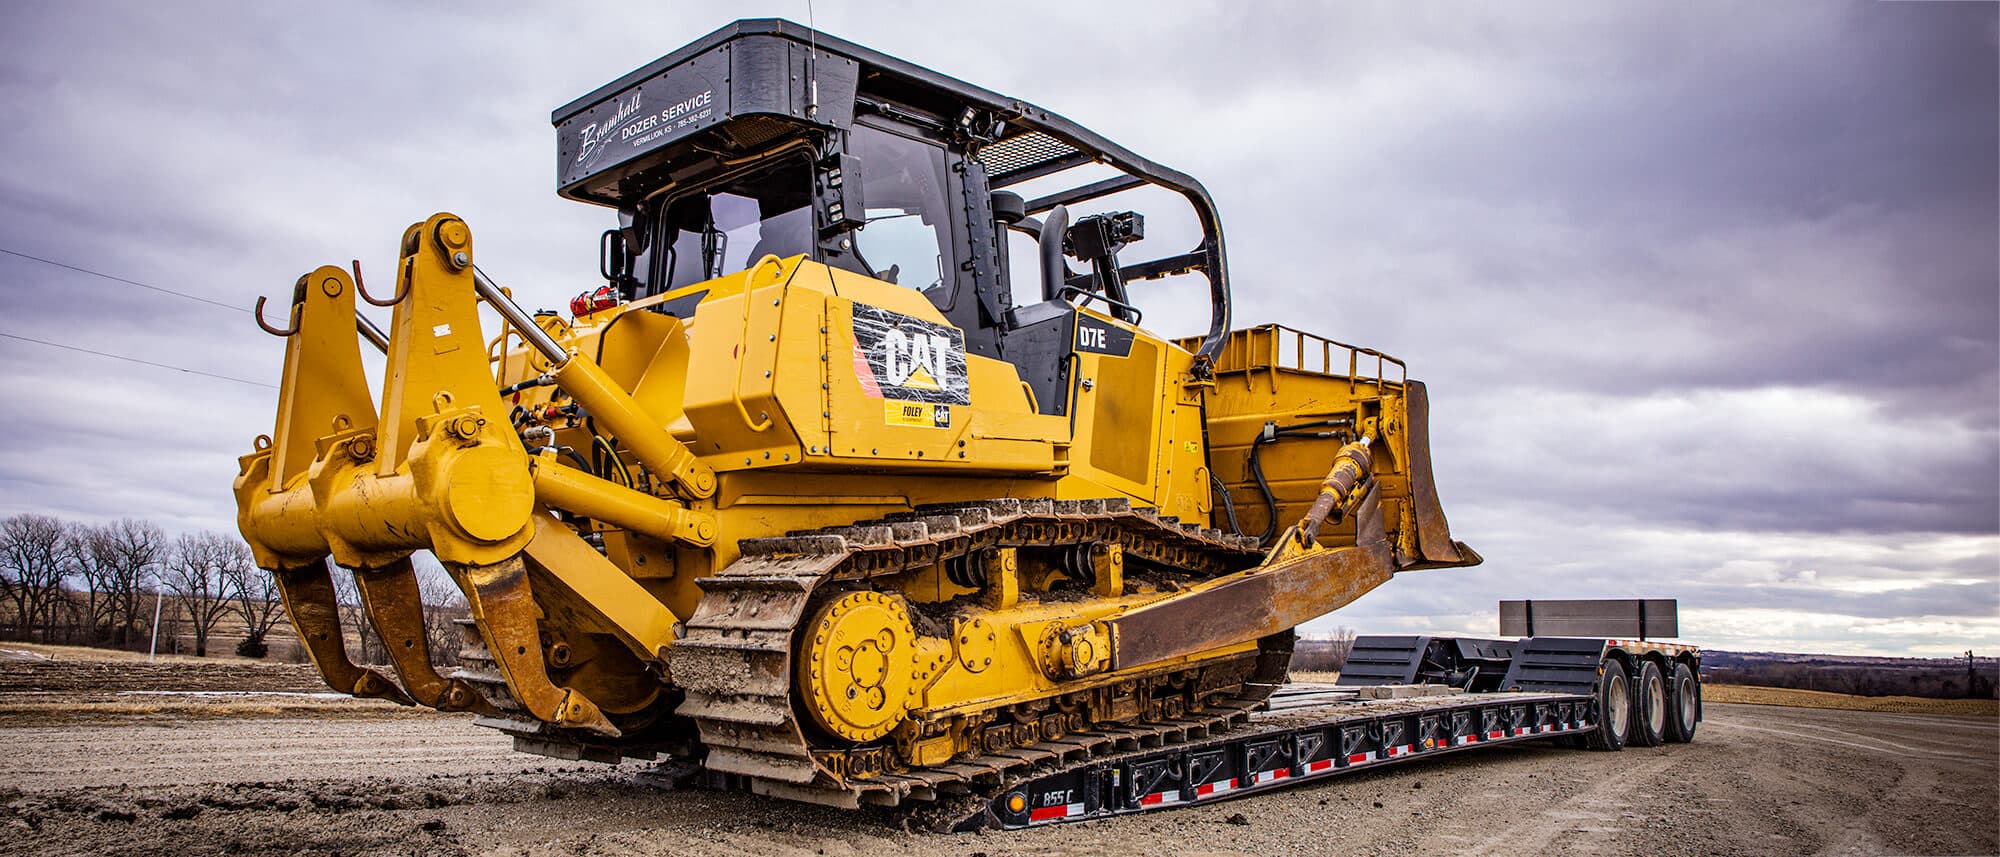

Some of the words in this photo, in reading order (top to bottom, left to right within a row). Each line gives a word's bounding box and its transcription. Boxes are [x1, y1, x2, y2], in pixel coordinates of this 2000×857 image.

[578, 93, 641, 161] Bramhall
[622, 115, 658, 140] DOZER
[661, 91, 712, 122] SERVICE
[1080, 326, 1106, 349] D7E
[885, 328, 951, 391] CAT
[902, 406, 923, 417] FOLEY
[935, 408, 949, 423] CAT
[1043, 791, 1064, 807] 855
